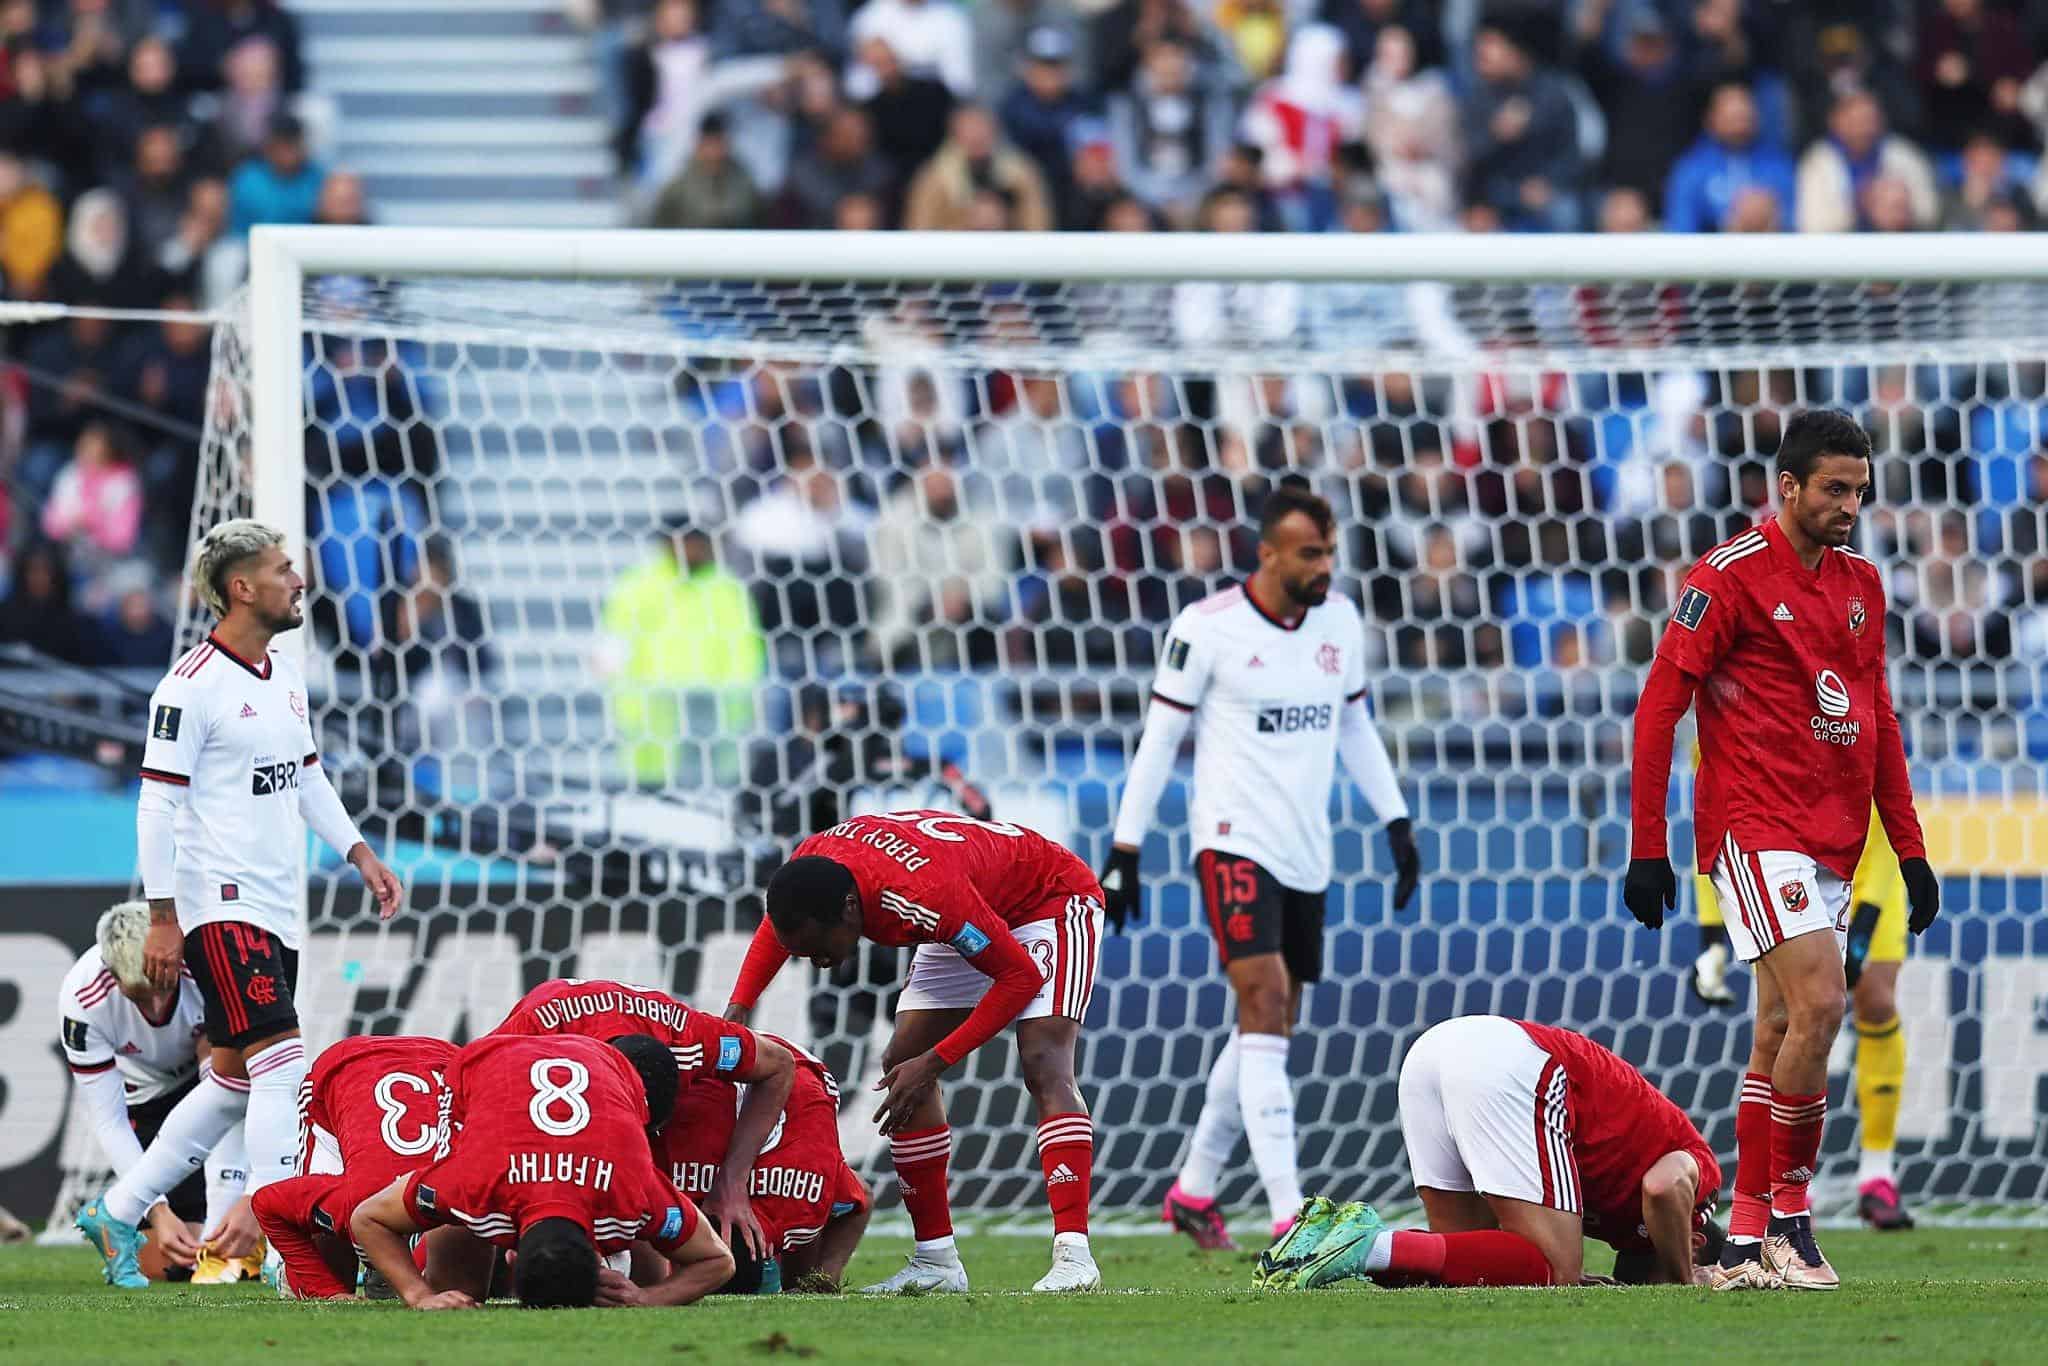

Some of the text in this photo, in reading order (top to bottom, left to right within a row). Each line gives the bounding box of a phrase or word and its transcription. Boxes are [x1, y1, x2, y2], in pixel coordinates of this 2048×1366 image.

[1285, 704, 1331, 732] BRB
[1810, 716, 1860, 734] ORGANI
[1814, 730, 1857, 745] GROUP
[276, 760, 298, 790] BR
[861, 828, 930, 872] PERCY
[1216, 860, 1257, 904] 15
[223, 922, 272, 966] 14
[374, 1071, 438, 1156] 3
[529, 1057, 591, 1137] 8
[508, 1152, 613, 1192] H.FATHY
